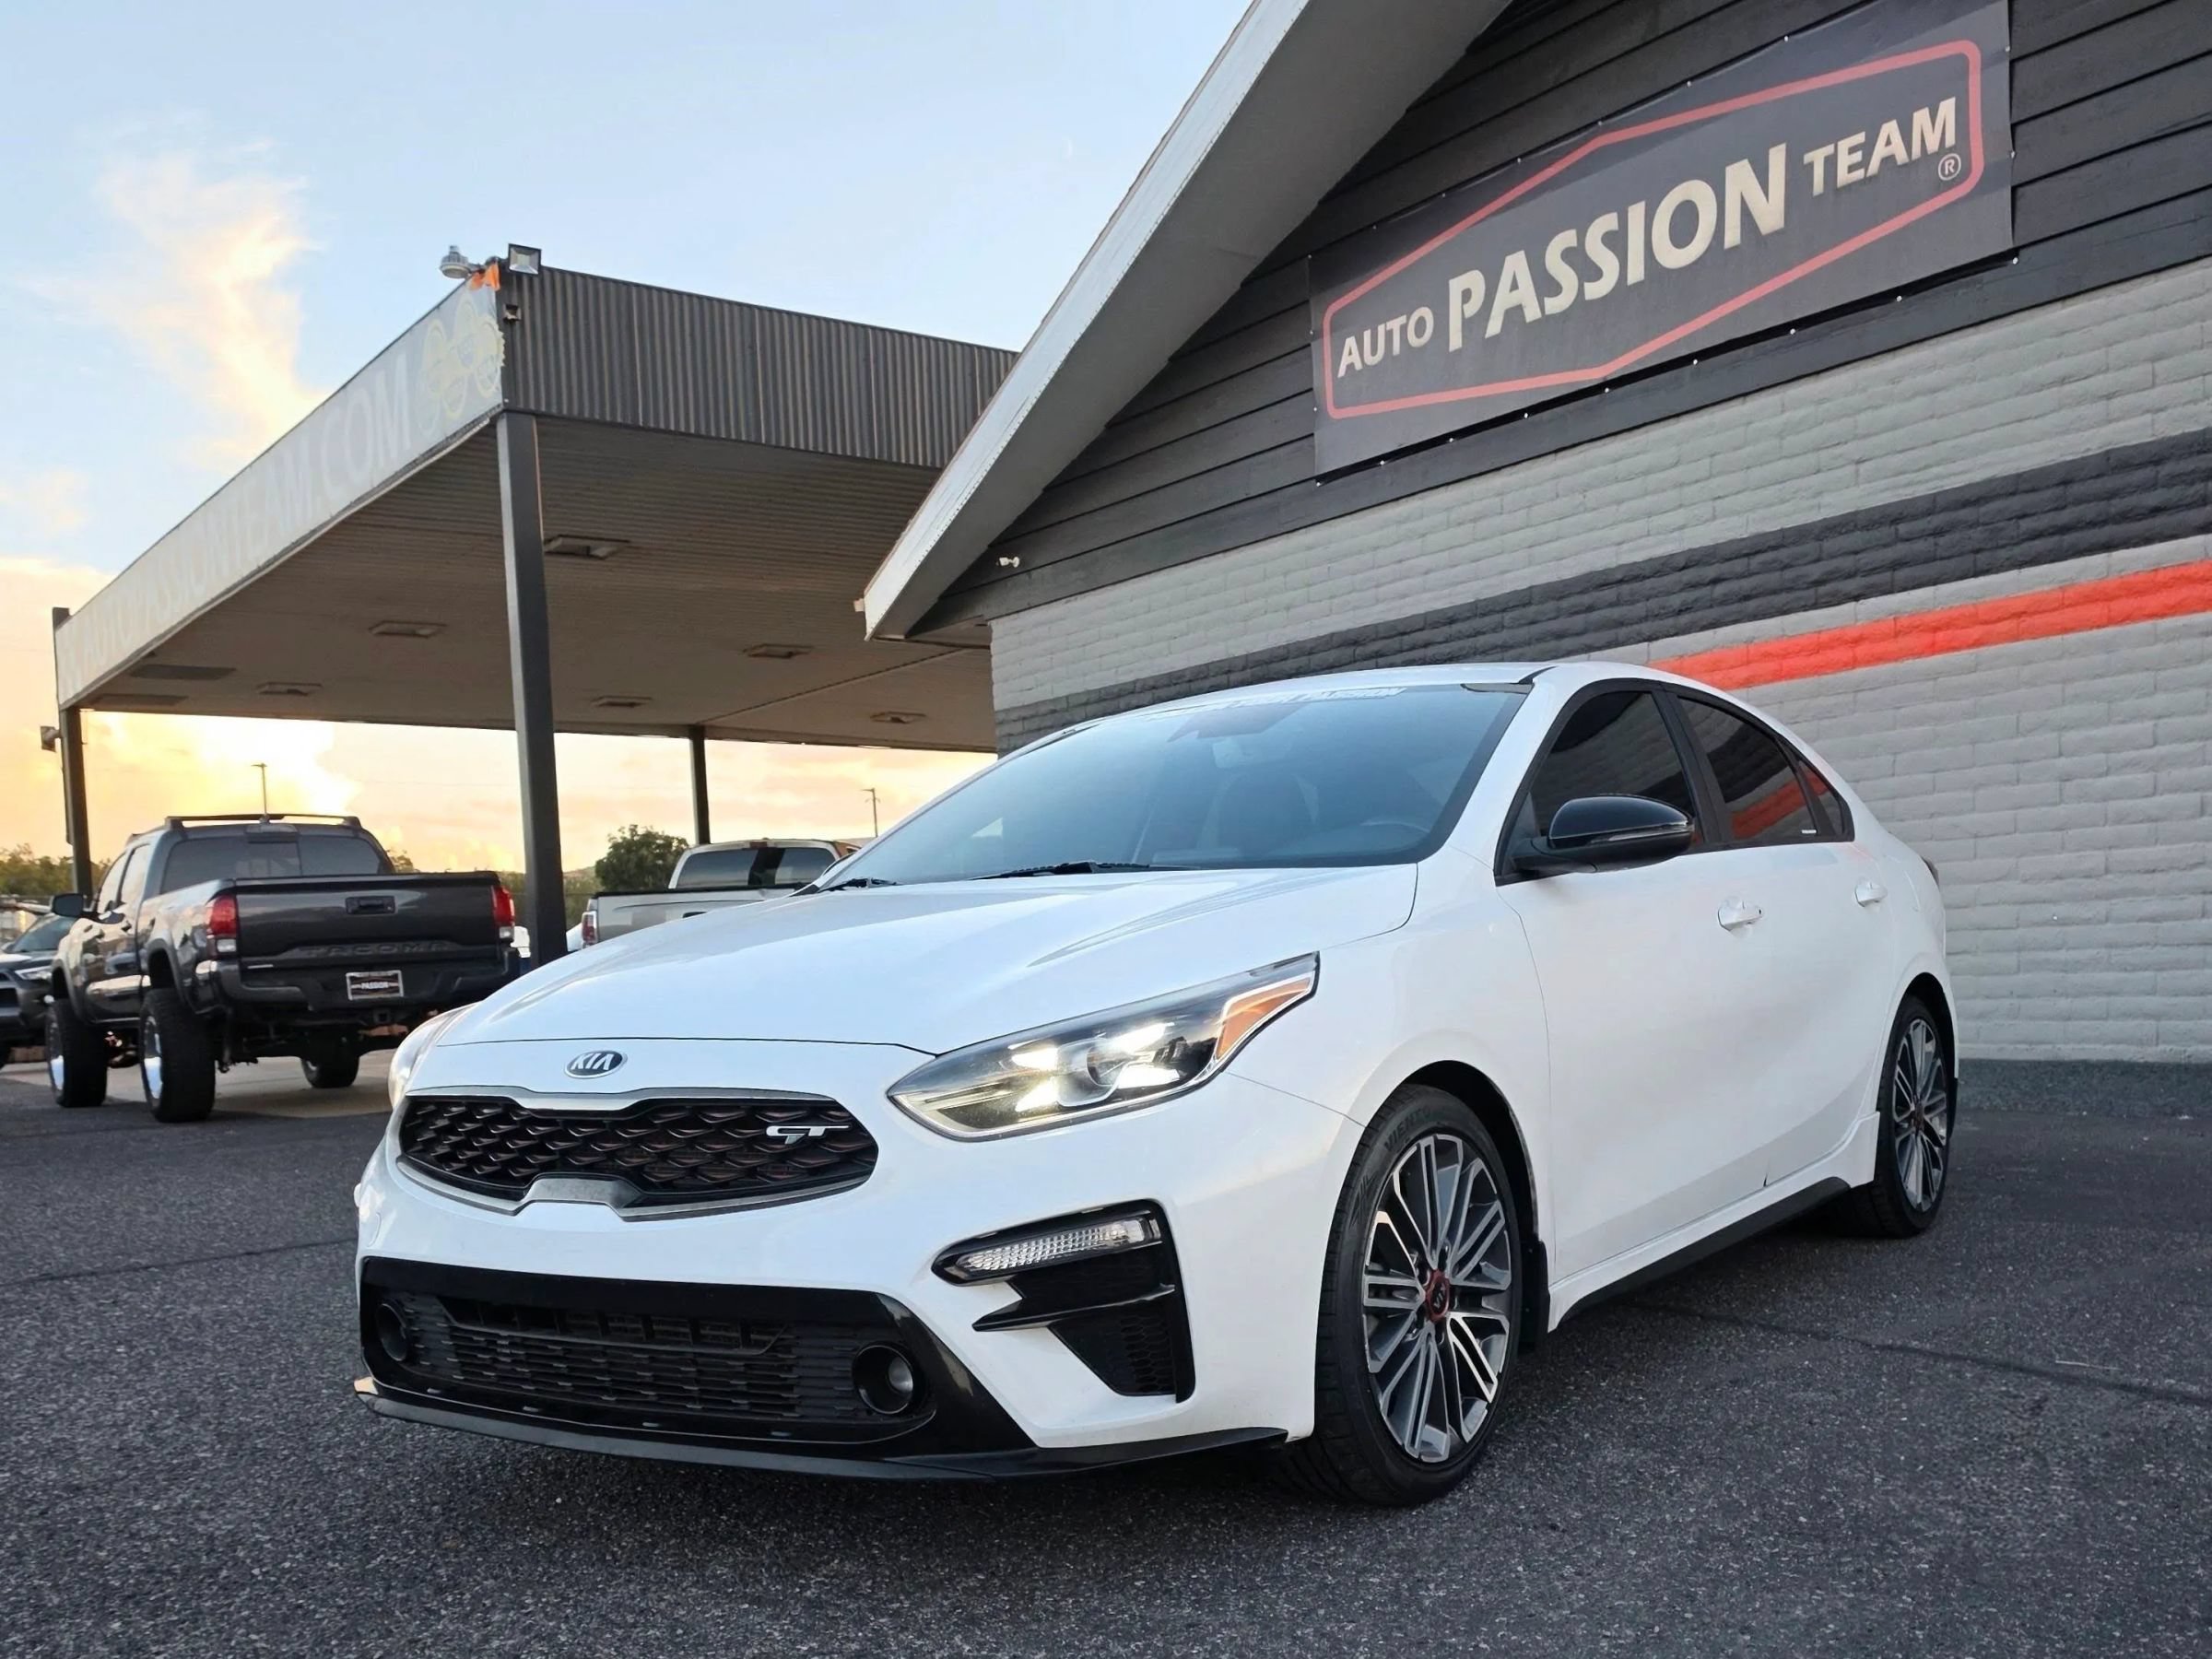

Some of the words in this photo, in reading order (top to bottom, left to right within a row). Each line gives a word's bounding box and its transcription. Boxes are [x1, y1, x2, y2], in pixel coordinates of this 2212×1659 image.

[1337, 305, 1433, 379] AUTO
[1448, 143, 1786, 352] PASSION
[1803, 97, 1957, 197] TEAM
[307, 941, 452, 958] TACOMA
[571, 1053, 616, 1071] KIA
[766, 1125, 850, 1145] GT
